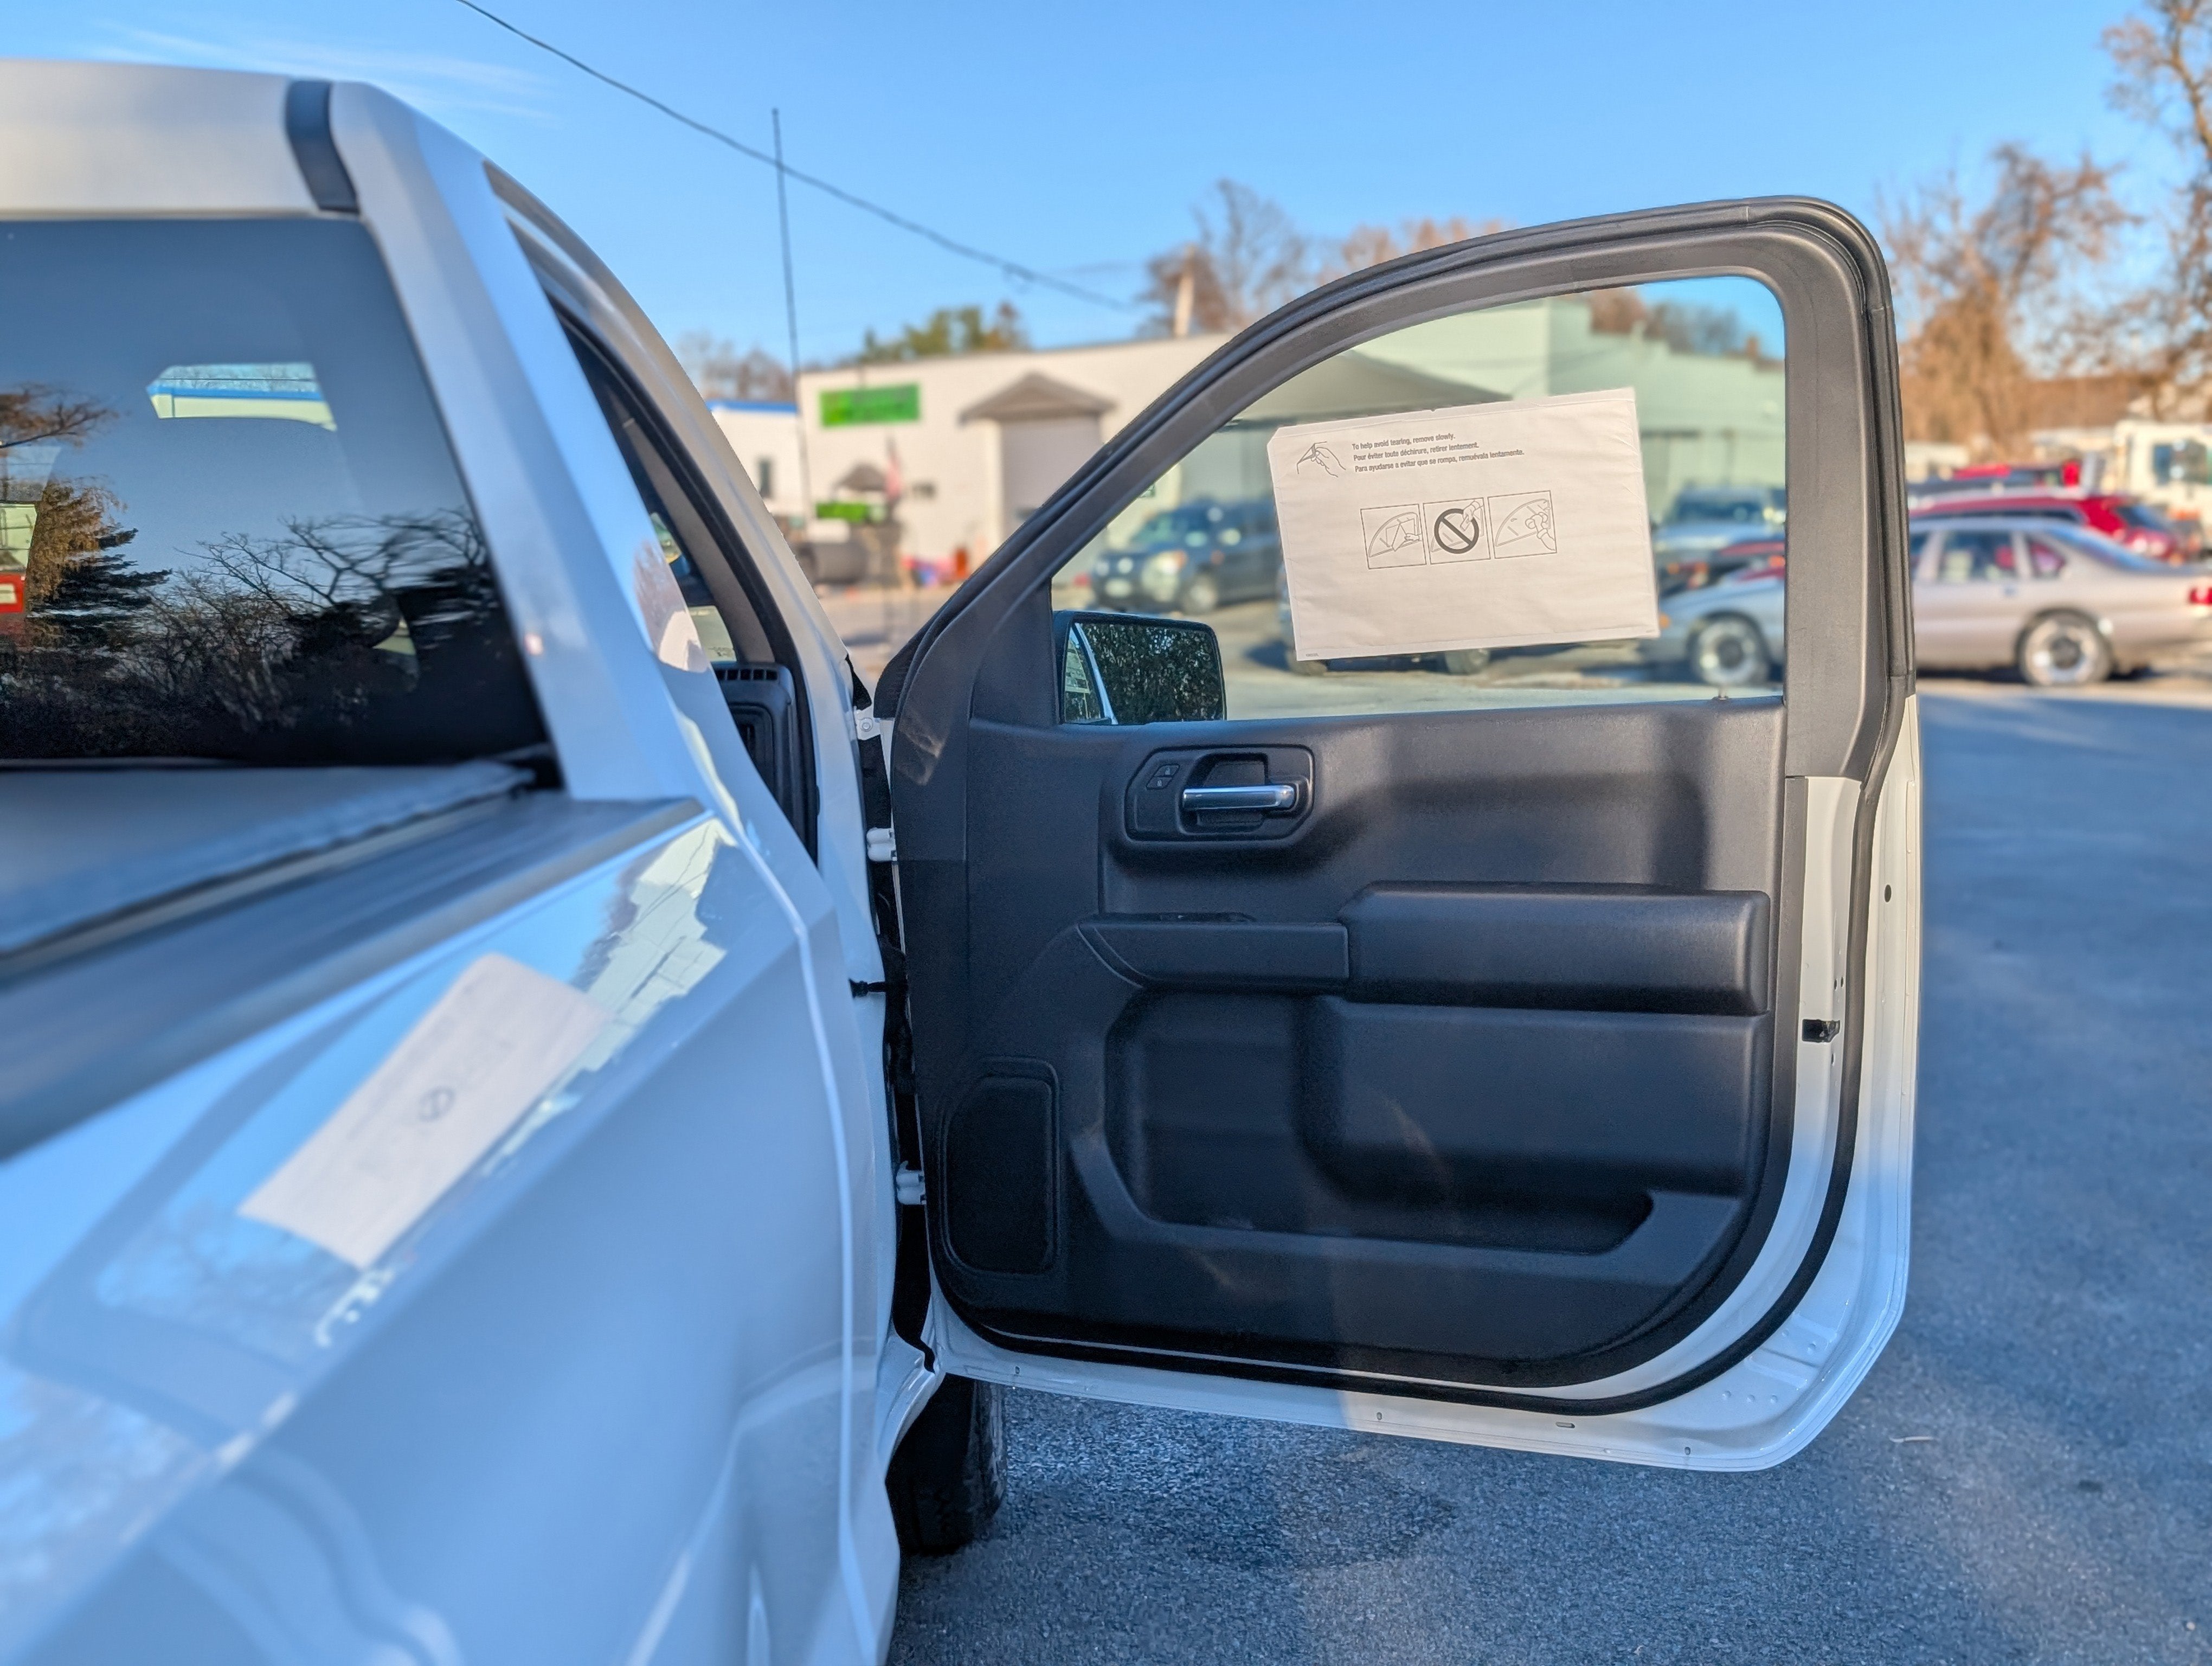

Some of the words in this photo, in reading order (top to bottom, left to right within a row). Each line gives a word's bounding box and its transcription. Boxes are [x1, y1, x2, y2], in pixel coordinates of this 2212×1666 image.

[1374, 440, 1389, 448] avoid
[1413, 435, 1434, 444] remove
[1400, 448, 1429, 456] déchirure,
[1449, 442, 1479, 451] lentement.
[1369, 463, 1394, 472] ayudarse
[1489, 449, 1525, 458] lentamente.
